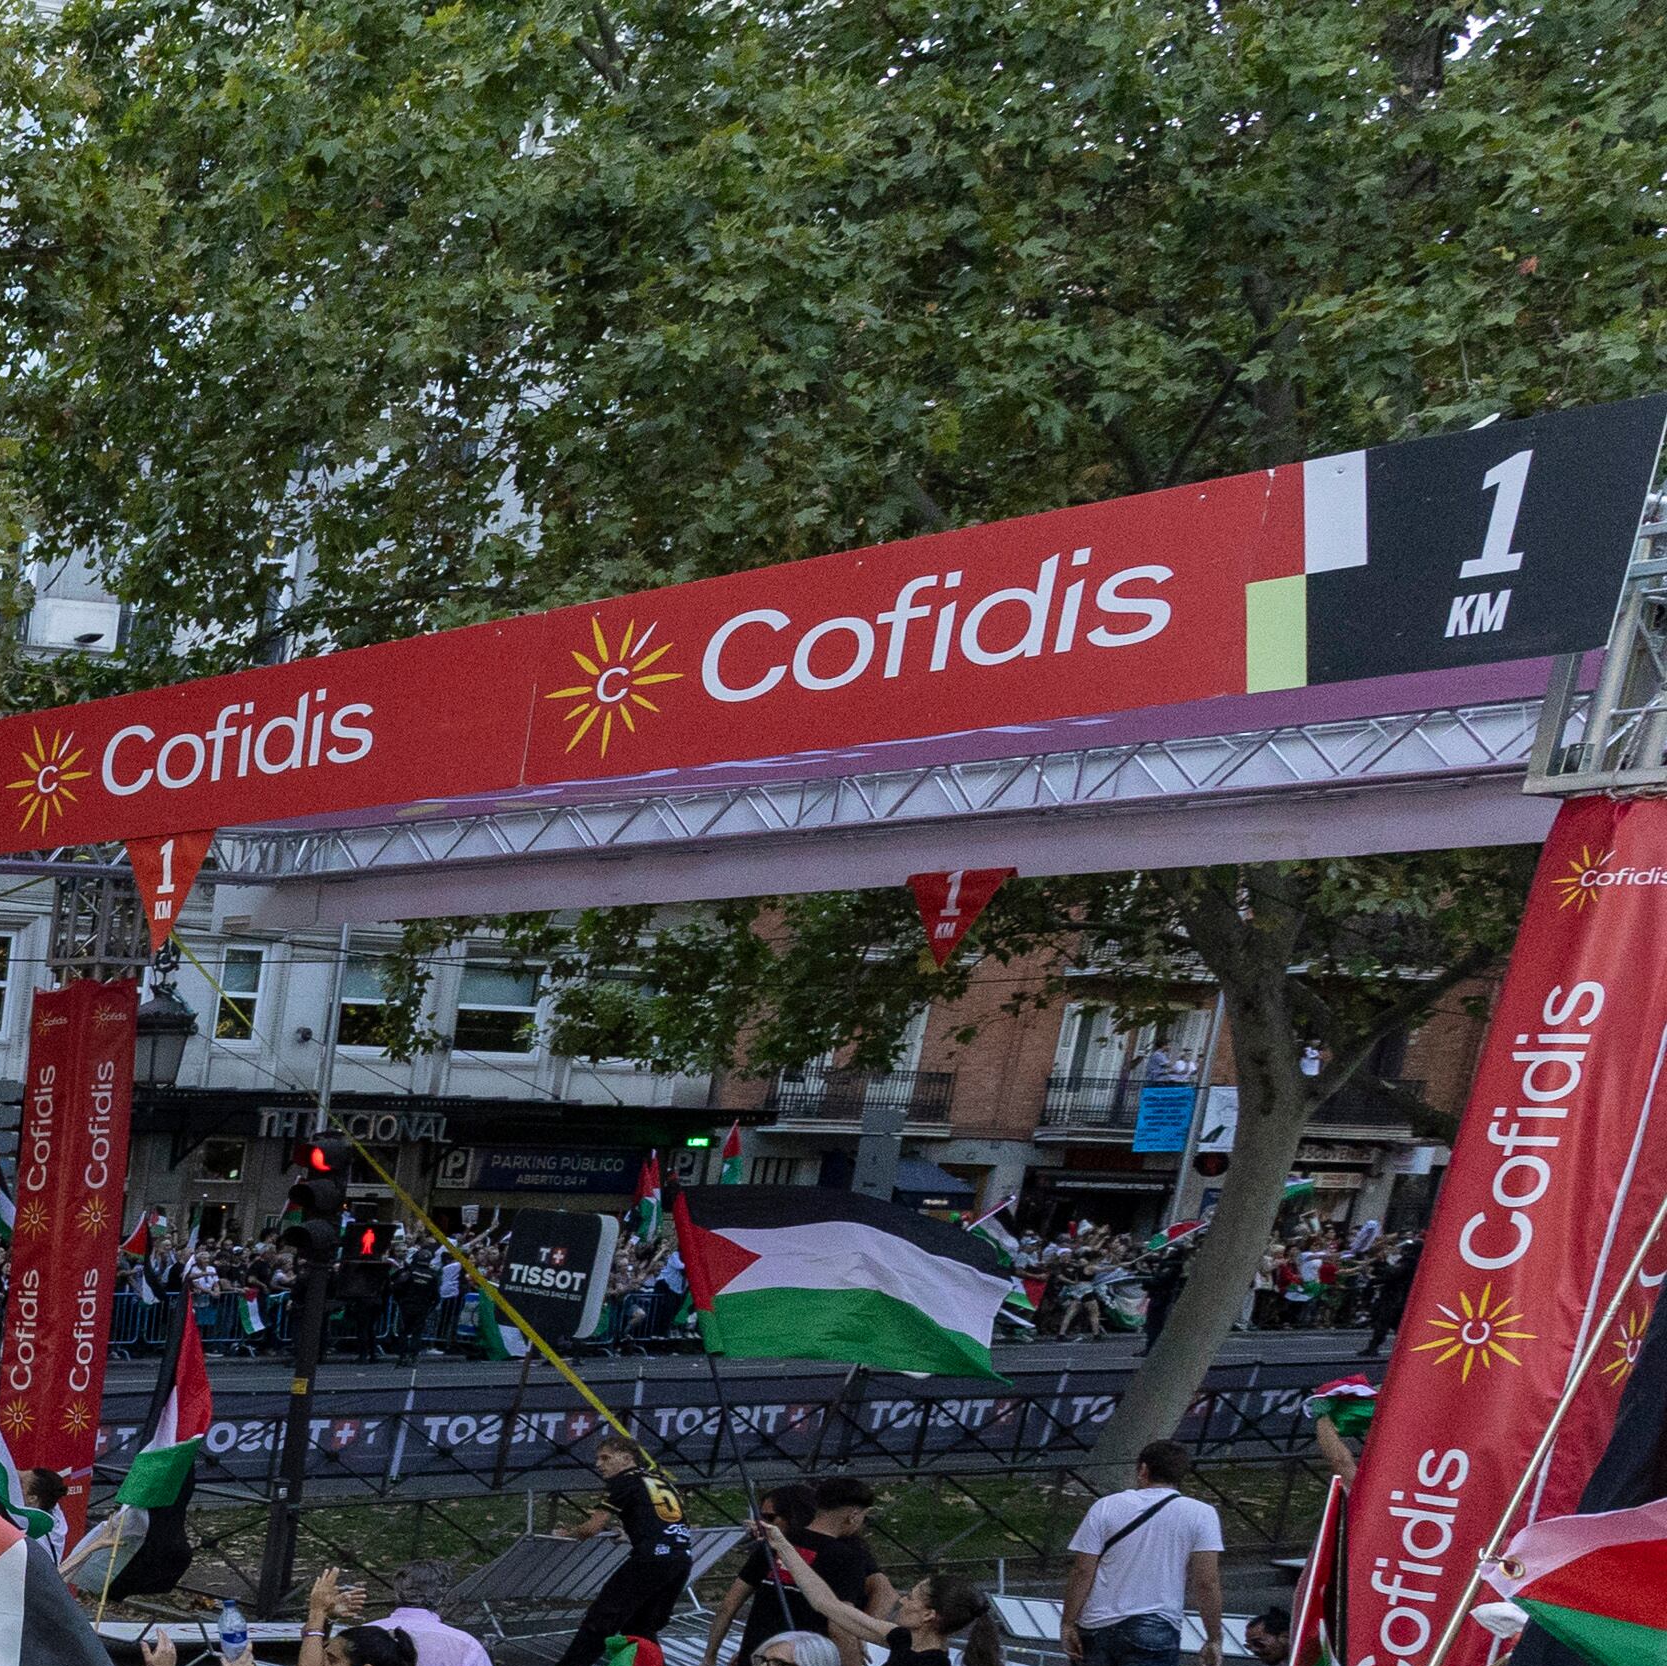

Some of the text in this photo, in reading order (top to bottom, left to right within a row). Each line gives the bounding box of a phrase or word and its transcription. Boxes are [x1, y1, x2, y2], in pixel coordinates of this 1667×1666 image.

[1460, 450, 1533, 578] 1
[701, 547, 1175, 703] Cofidis
[1444, 589, 1513, 639] KM
[101, 688, 374, 796] Cofidis
[157, 839, 175, 894] 1
[938, 871, 963, 916] 1
[154, 900, 172, 921] KM
[934, 921, 956, 939] KM
[27, 1064, 56, 1192] Cofidis
[85, 1060, 115, 1190] Cofidis
[1458, 980, 1606, 1271] Cofidis
[491, 1153, 625, 1173] PARKING PÚBLICO
[517, 1173, 561, 1186] ABIERTO
[510, 1263, 587, 1292] TISSOT
[10, 1268, 40, 1392] Cofidis
[68, 1267, 99, 1393] Cofidis
[642, 1475, 683, 1523] 5
